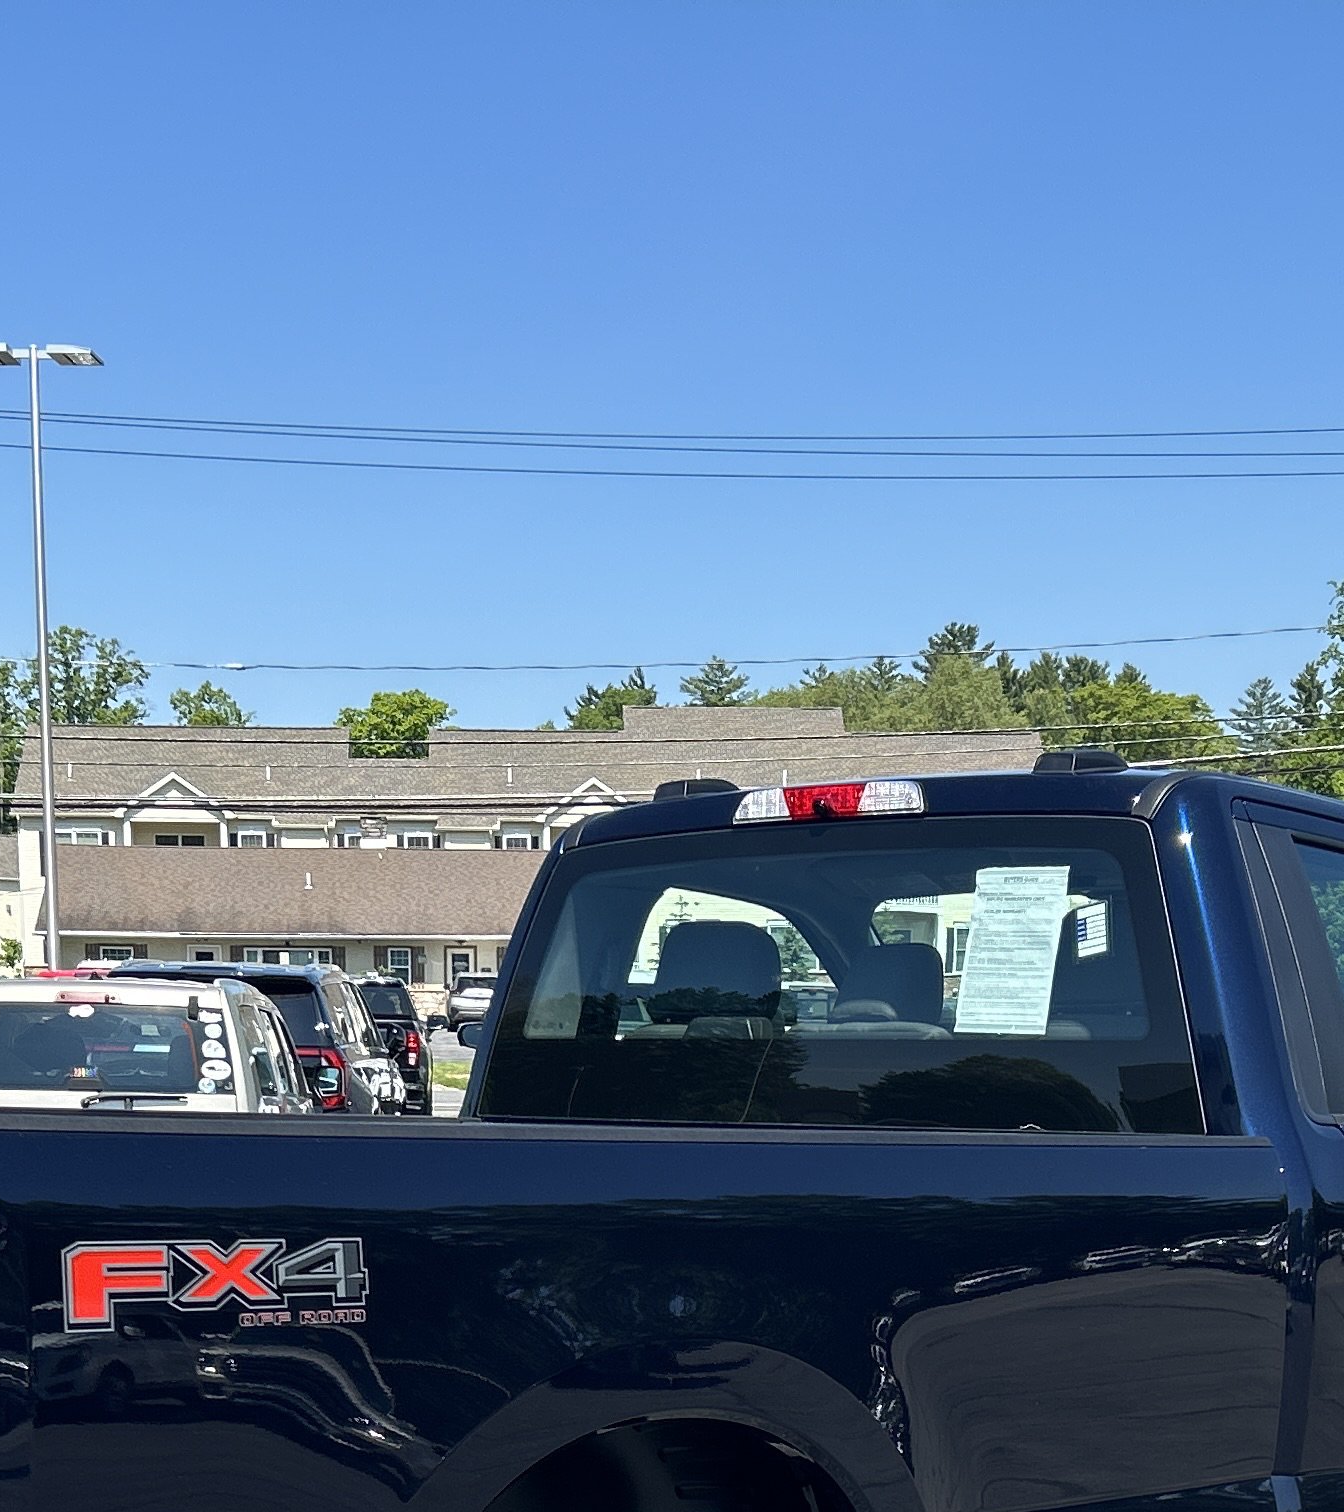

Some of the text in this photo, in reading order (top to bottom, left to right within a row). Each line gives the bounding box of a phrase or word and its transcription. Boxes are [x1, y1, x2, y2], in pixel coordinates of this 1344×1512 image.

[61, 1238, 369, 1333] FX4
[239, 1308, 367, 1327] OFF ROAD
